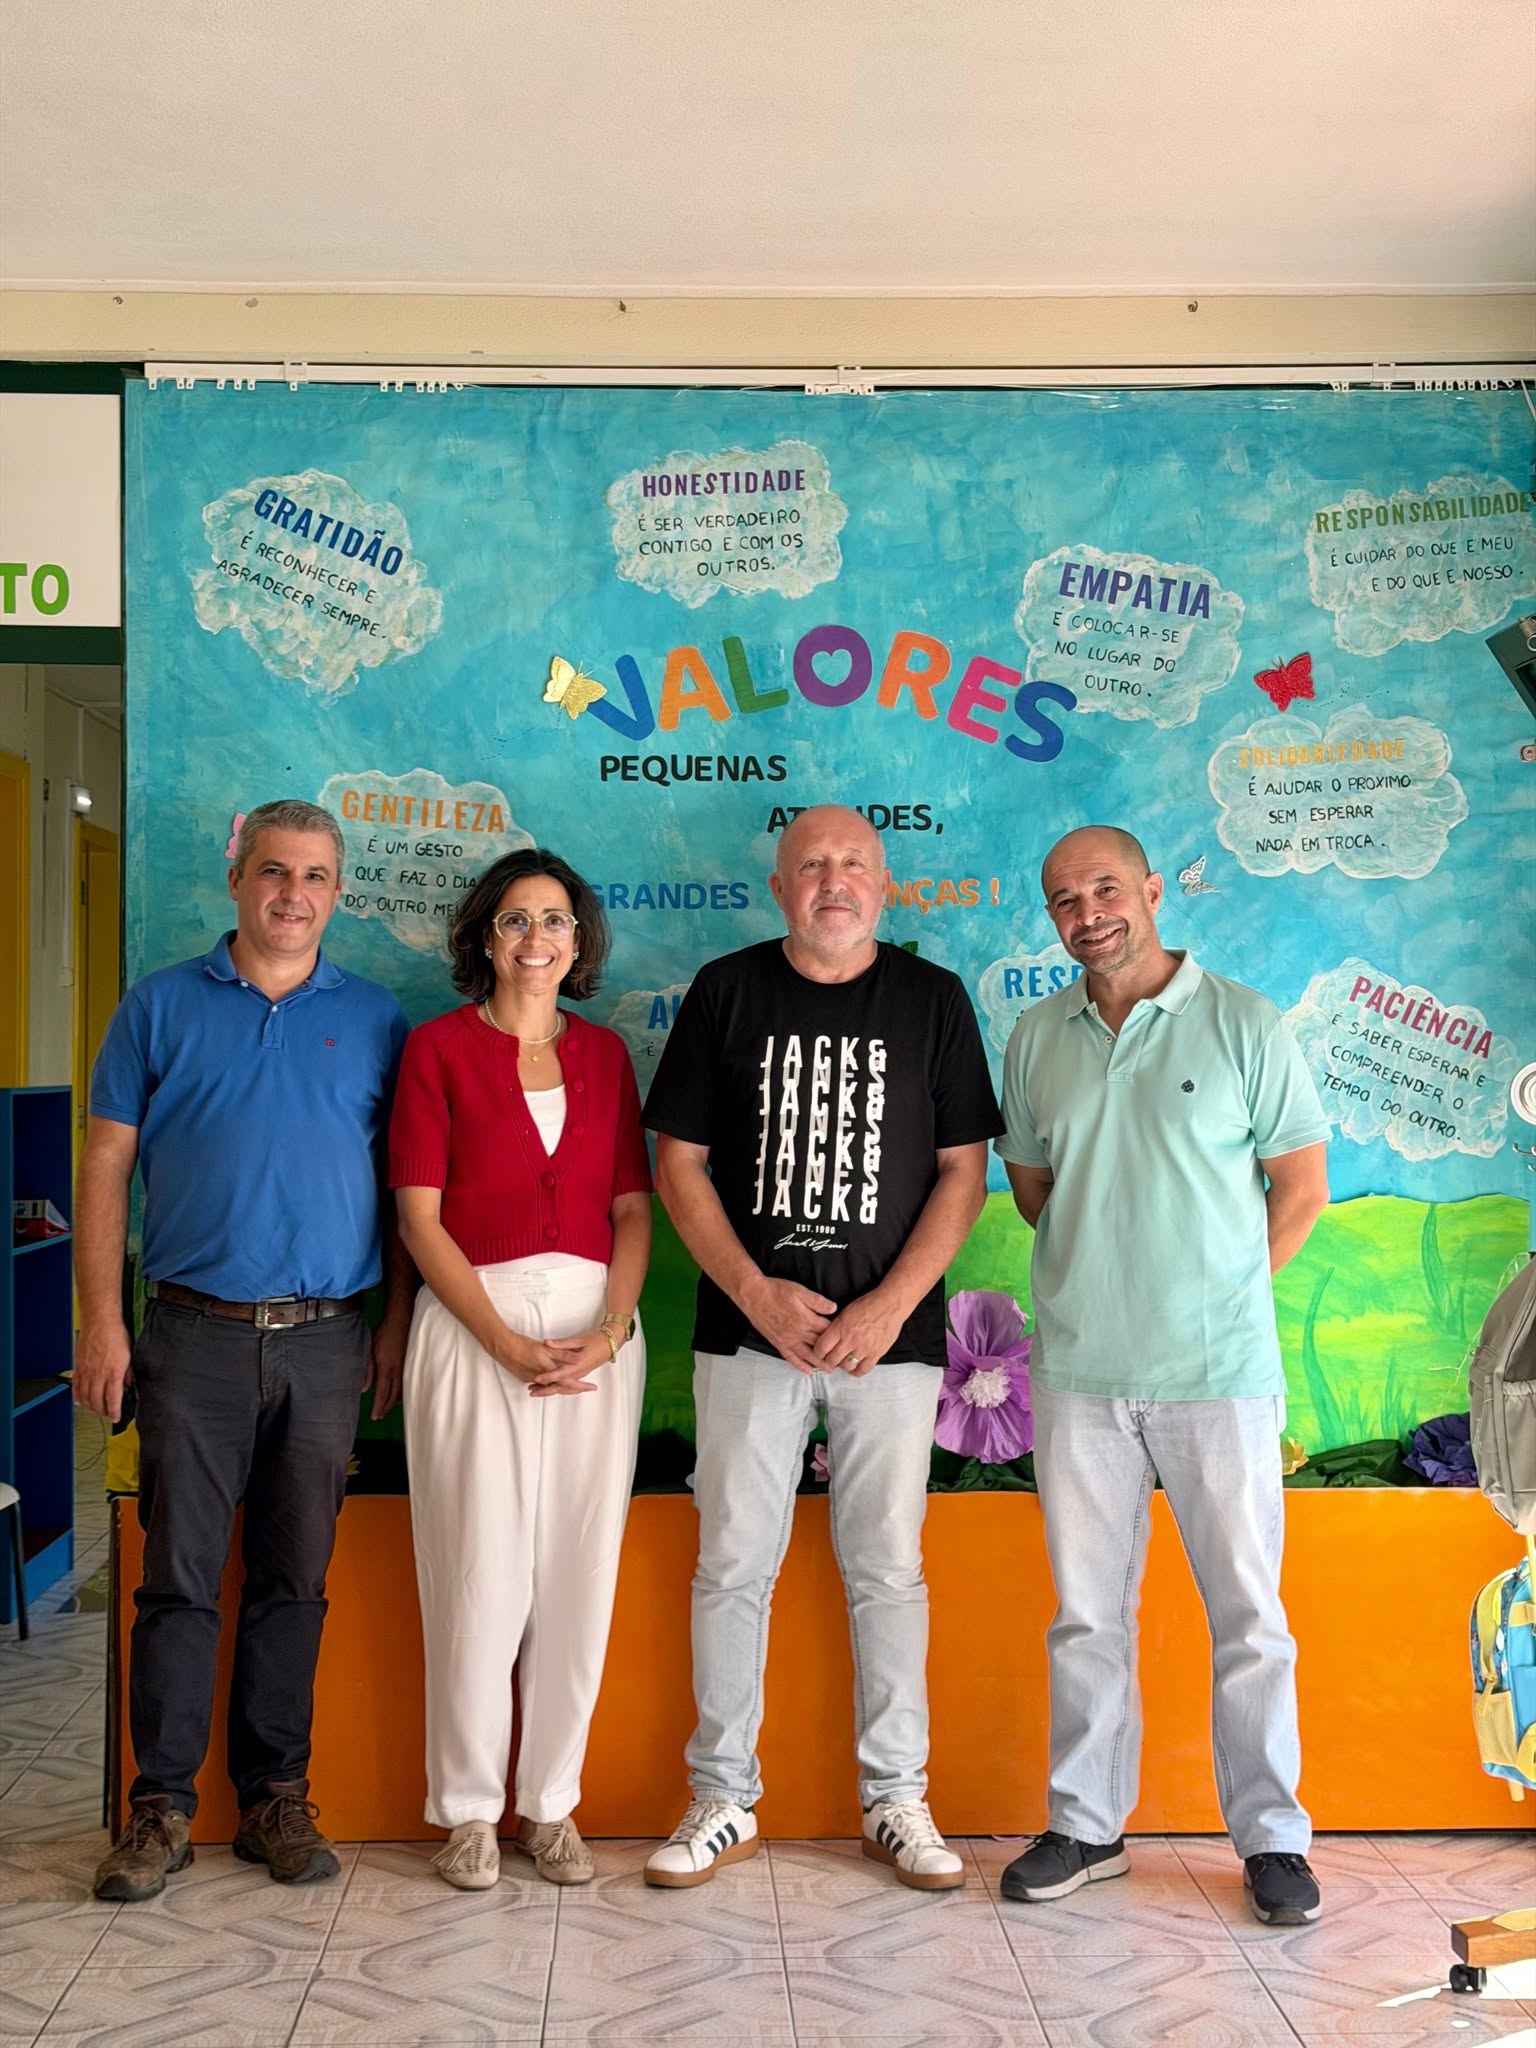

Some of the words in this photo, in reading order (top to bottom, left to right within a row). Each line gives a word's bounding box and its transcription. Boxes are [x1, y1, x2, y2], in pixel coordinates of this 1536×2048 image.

[642, 469, 806, 498] HONESTIDADE
[638, 514, 646, 531] É
[654, 517, 683, 531] SER
[694, 509, 801, 528] VERDADEIRO
[1315, 491, 1530, 534] RESPONSABILIDADE
[254, 489, 403, 576] GRATIDÃO
[639, 538, 712, 555] CONTIGO
[723, 537, 732, 551] E
[739, 535, 774, 550] COM
[781, 533, 803, 548] OS
[240, 531, 253, 550] É
[255, 542, 358, 597] RECONHECER
[365, 589, 377, 604] E
[697, 557, 775, 576] OUTROS.
[1331, 548, 1339, 567] É
[1345, 549, 1396, 565] CUIDAR
[1406, 545, 1425, 558] DO
[1431, 541, 1457, 556] QUE
[1481, 537, 1513, 550] MEU
[1058, 562, 1210, 619] EMPATIA
[1372, 578, 1380, 592] E
[1387, 576, 1406, 590] DO
[1413, 572, 1441, 589] QUE
[217, 559, 314, 608] AGRADECER
[321, 602, 386, 639] SEMPRE.
[1053, 606, 1065, 627] É
[1071, 615, 1180, 643] COLOCAR-SE
[1054, 640, 1078, 655] NO
[1088, 647, 1141, 666] LUGAR
[1153, 657, 1176, 673] DO
[587, 624, 1078, 763] VALORES
[1238, 739, 1406, 768] SOLIDARIEDADE
[600, 754, 788, 787] PEQUENAS
[1249, 776, 1257, 796] É
[1264, 780, 1322, 796] AJUDAR
[1331, 778, 1341, 792] O
[1348, 774, 1412, 791] PROXIMO
[341, 790, 505, 833] GENTILEZA
[1269, 809, 1297, 824] SEM
[1310, 805, 1374, 822] ESPERAR
[367, 834, 378, 853] É
[385, 841, 409, 854] UM
[415, 842, 463, 858] GESTO
[1256, 837, 1292, 853] NADA
[1302, 837, 1320, 852] EM
[355, 866, 387, 882] QUE
[400, 870, 427, 886] FAZ
[436, 874, 446, 888] O
[453, 875, 477, 889] DIA
[345, 894, 367, 909] DO
[377, 897, 427, 915] OUTRO
[1349, 976, 1493, 1058] PACIÊNCIA
[1348, 1022, 1402, 1055] SABER
[1407, 1046, 1470, 1081] ESPERAR
[1476, 1075, 1486, 1088] E
[1331, 1045, 1444, 1103] COMPREENDER
[1453, 1097, 1464, 1110] O
[1323, 1072, 1370, 1101] TEMPO
[1380, 1099, 1401, 1116] DO
[1409, 1111, 1461, 1140] OUTRO.
